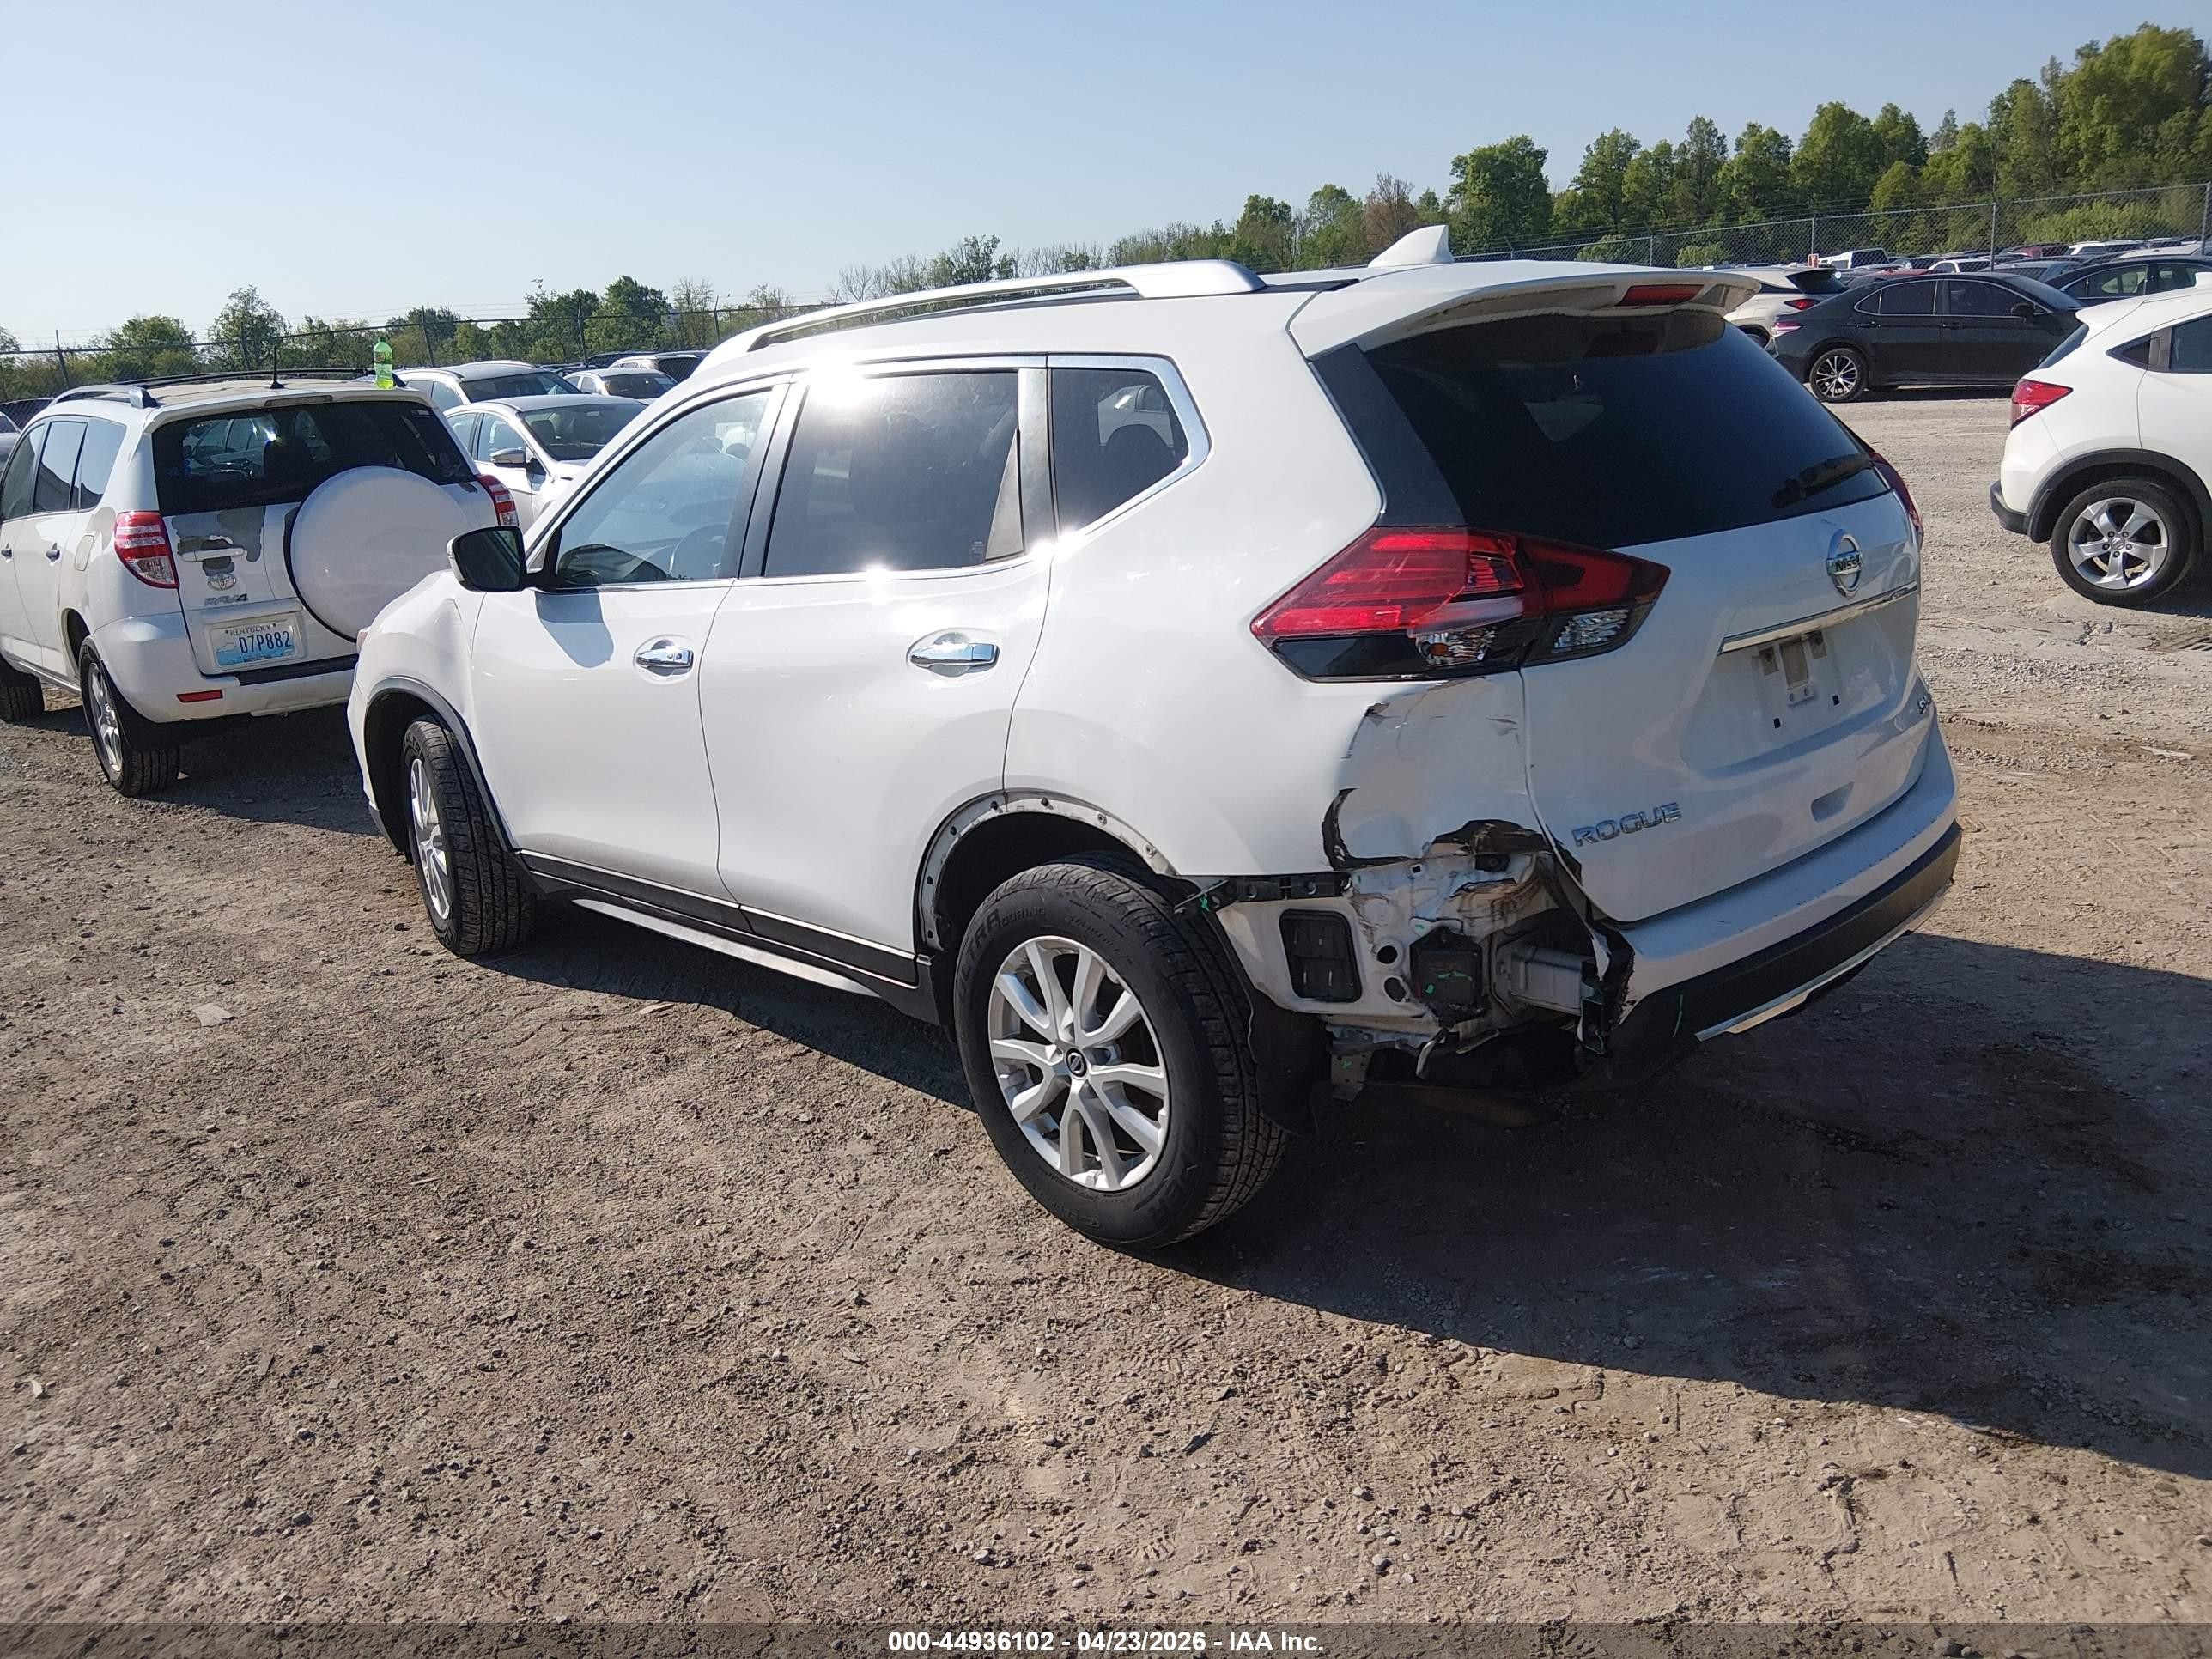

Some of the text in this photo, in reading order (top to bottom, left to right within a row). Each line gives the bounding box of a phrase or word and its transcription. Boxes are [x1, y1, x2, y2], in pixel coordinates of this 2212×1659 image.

[204, 593, 249, 606] RAV4
[229, 624, 270, 635] KENTUCKY
[239, 630, 292, 653] D7P882
[1571, 802, 1682, 847] ROGUE
